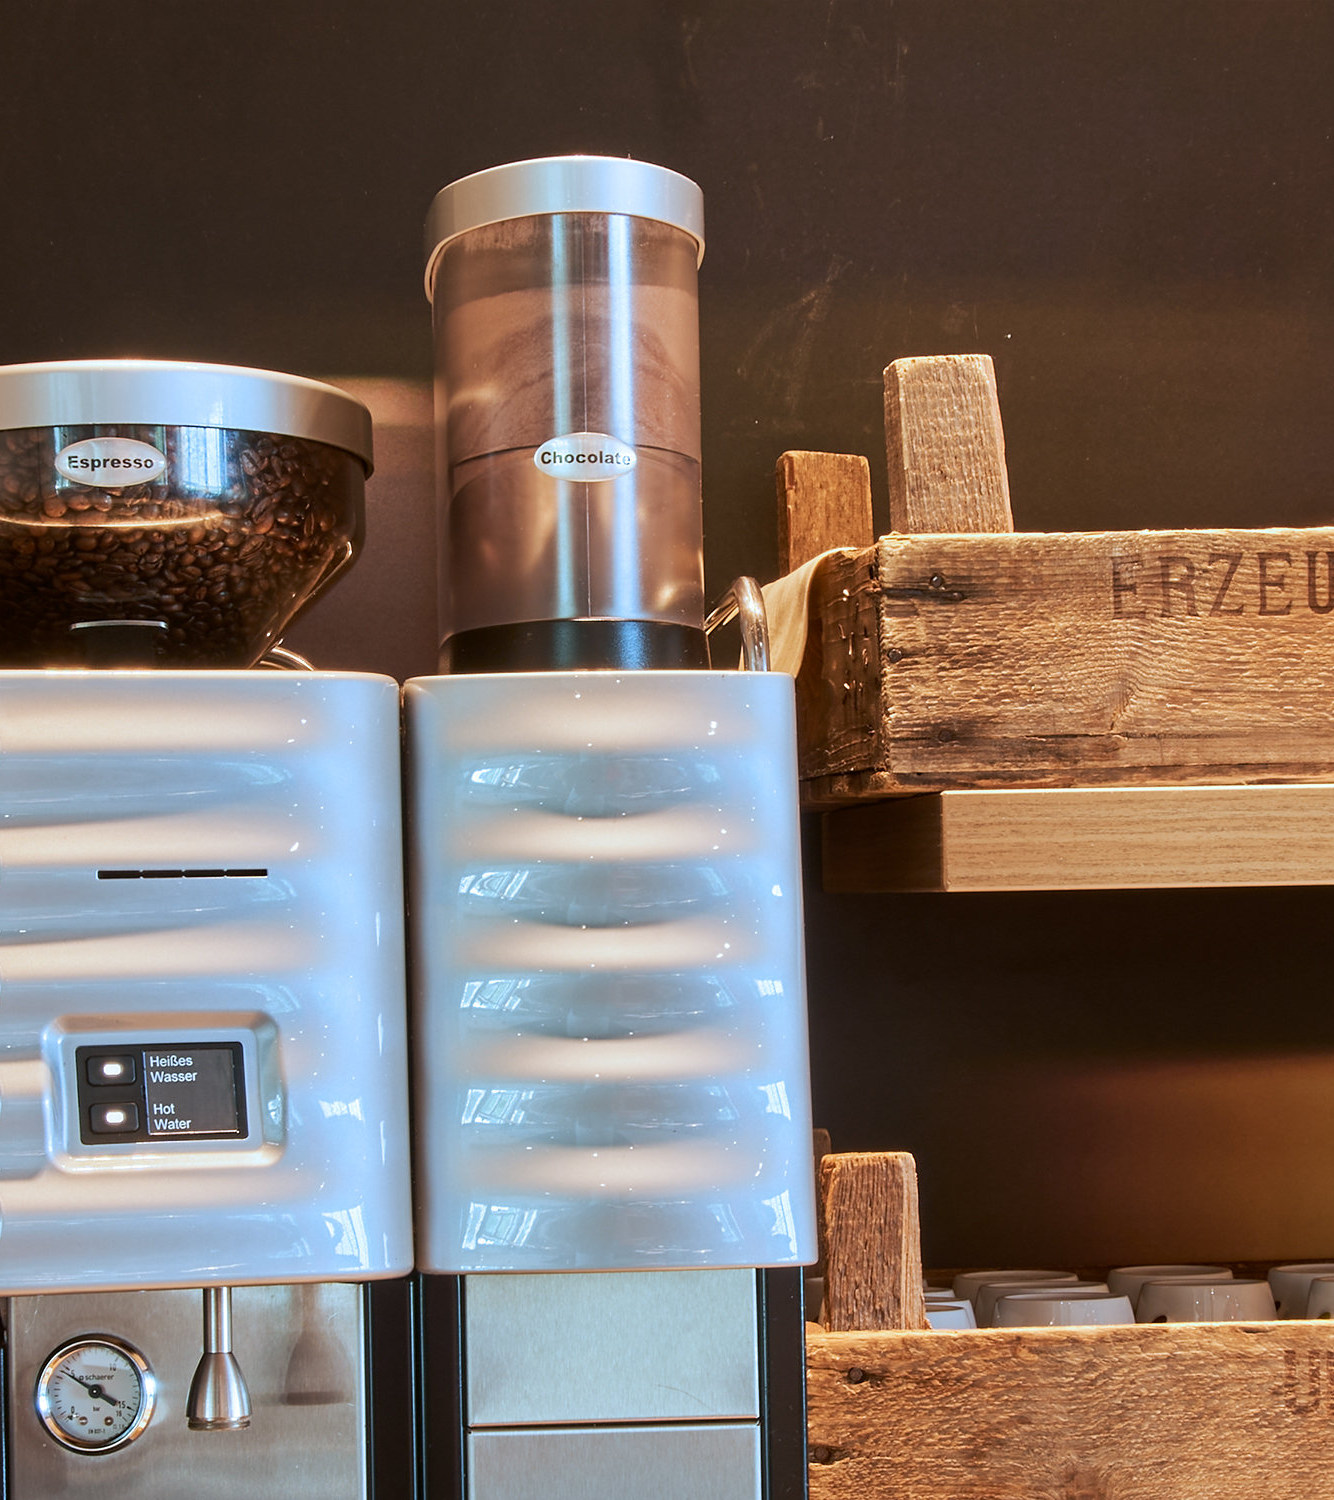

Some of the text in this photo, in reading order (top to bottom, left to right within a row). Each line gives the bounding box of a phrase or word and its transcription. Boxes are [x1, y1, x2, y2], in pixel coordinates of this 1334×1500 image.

[67, 455, 154, 472] Espresso
[540, 450, 631, 466] Chocolate
[149, 1055, 194, 1068] Heißes
[150, 1071, 198, 1084] Wasser
[153, 1103, 176, 1116] Hot
[154, 1118, 192, 1131] Water
[85, 1373, 115, 1381] schaerer
